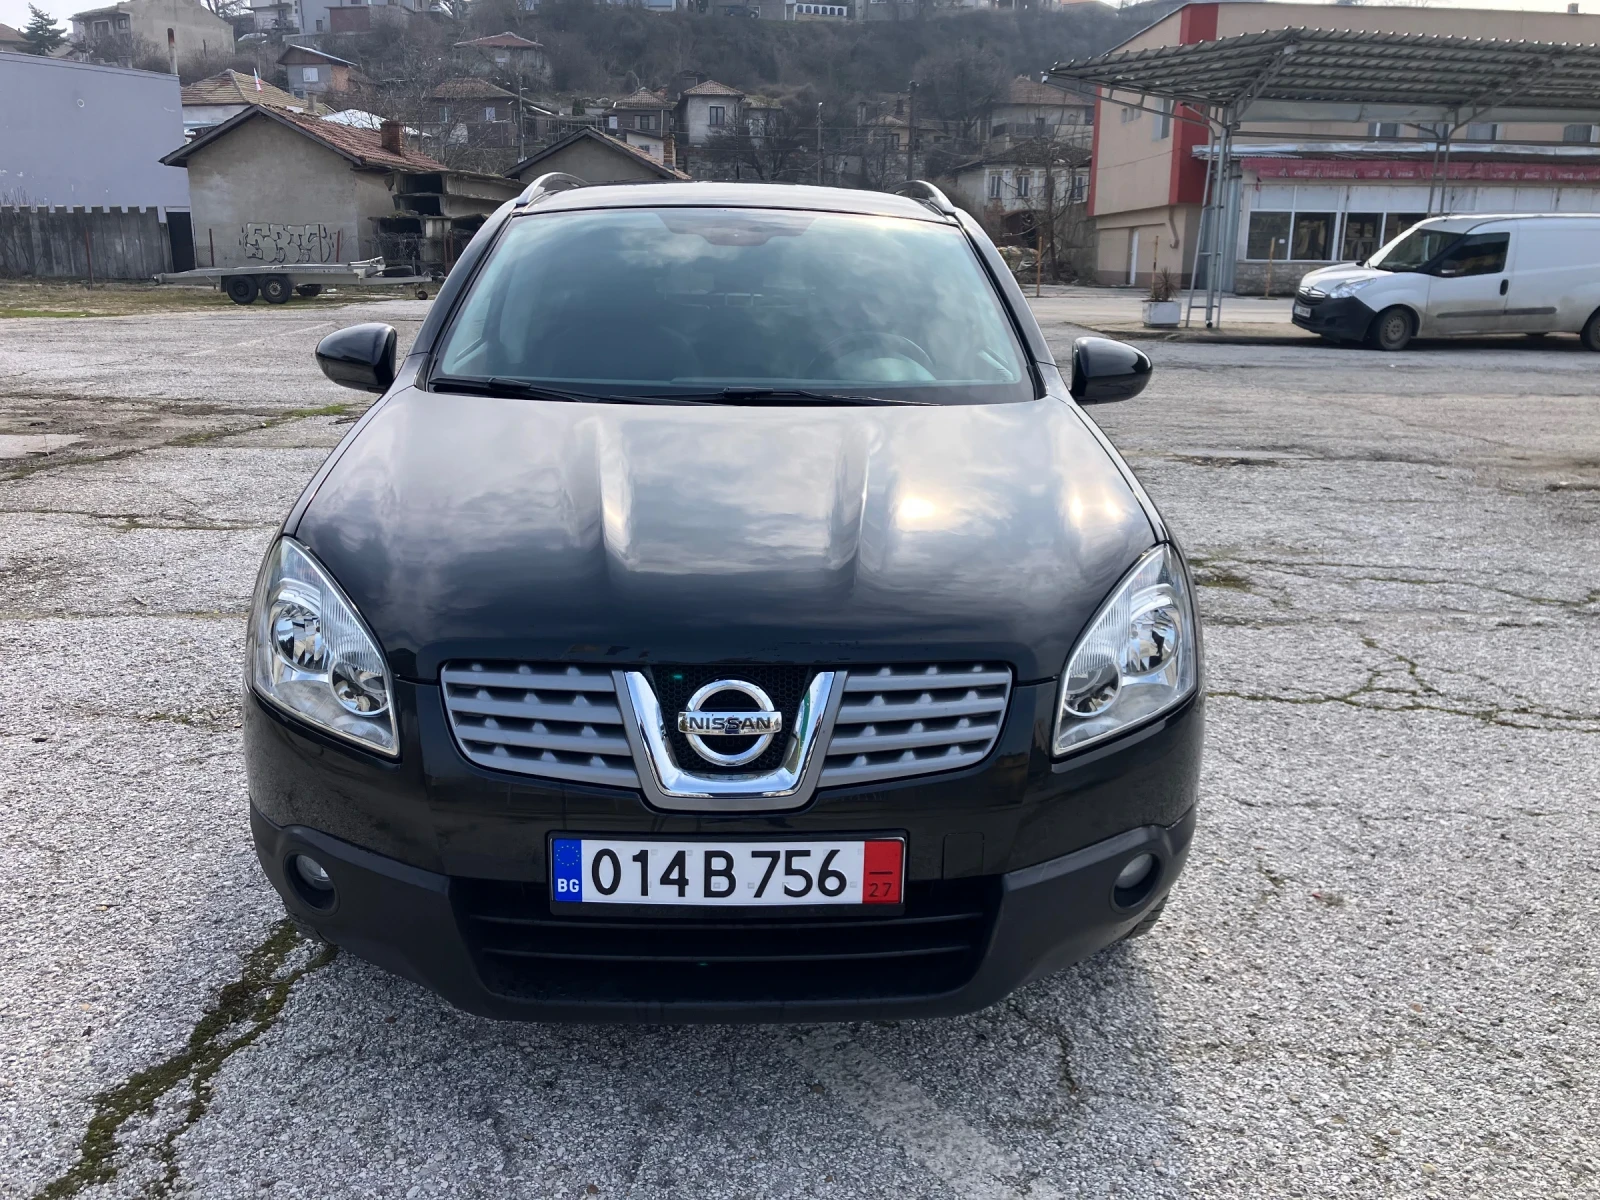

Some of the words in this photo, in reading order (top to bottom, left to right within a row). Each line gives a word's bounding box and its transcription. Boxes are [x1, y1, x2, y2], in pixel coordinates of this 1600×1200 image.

[689, 716, 771, 730] NISSAN
[557, 878, 580, 893] BG
[868, 882, 893, 898] 27
